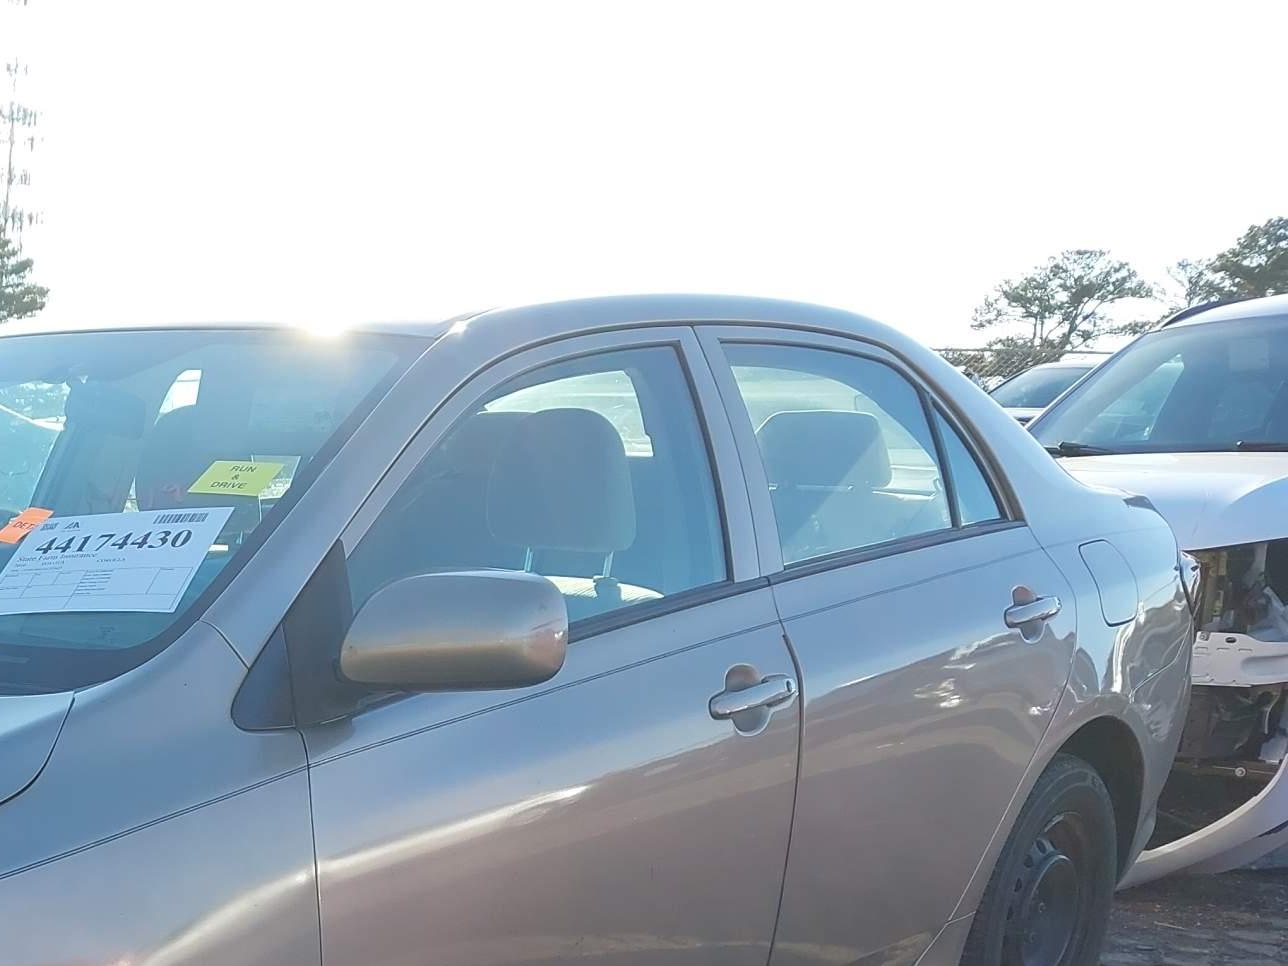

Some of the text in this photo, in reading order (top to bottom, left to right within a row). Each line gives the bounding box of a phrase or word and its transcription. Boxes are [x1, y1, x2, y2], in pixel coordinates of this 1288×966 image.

[231, 465, 257, 473] RUN
[210, 481, 247, 490] DRIVE
[35, 529, 193, 555] 44174430
